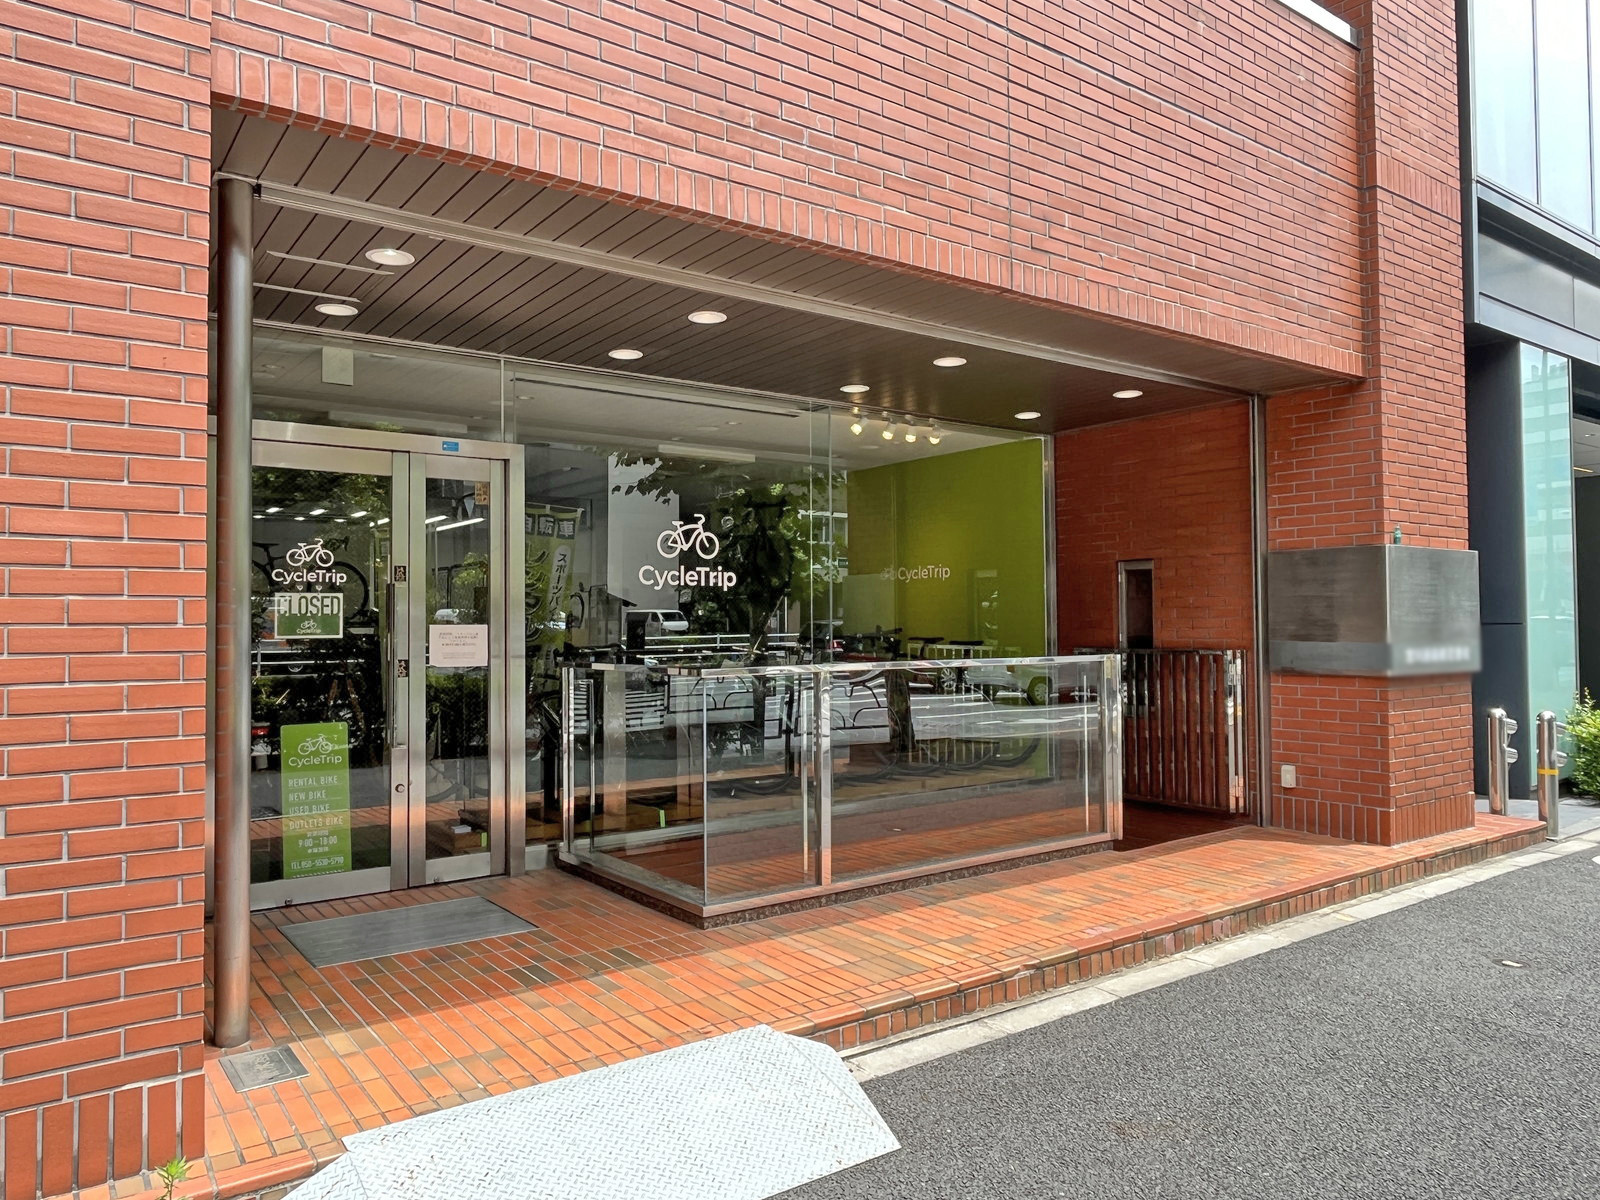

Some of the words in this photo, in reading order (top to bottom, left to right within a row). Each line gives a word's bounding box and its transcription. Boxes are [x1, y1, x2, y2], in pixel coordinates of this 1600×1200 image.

[271, 569, 347, 586] CycleTrip
[638, 565, 737, 591] CycleTrip
[898, 564, 951, 583] CycleTrip
[277, 595, 341, 616] CLOSED
[288, 755, 343, 768] CycleTrip
[288, 777, 317, 788] RENTAL
[320, 775, 338, 785] BIKE
[288, 791, 306, 802] NEW
[309, 790, 327, 800] BIKE
[289, 805, 310, 815] USED
[312, 804, 330, 813] BIKE
[325, 816, 344, 826] BIKE
